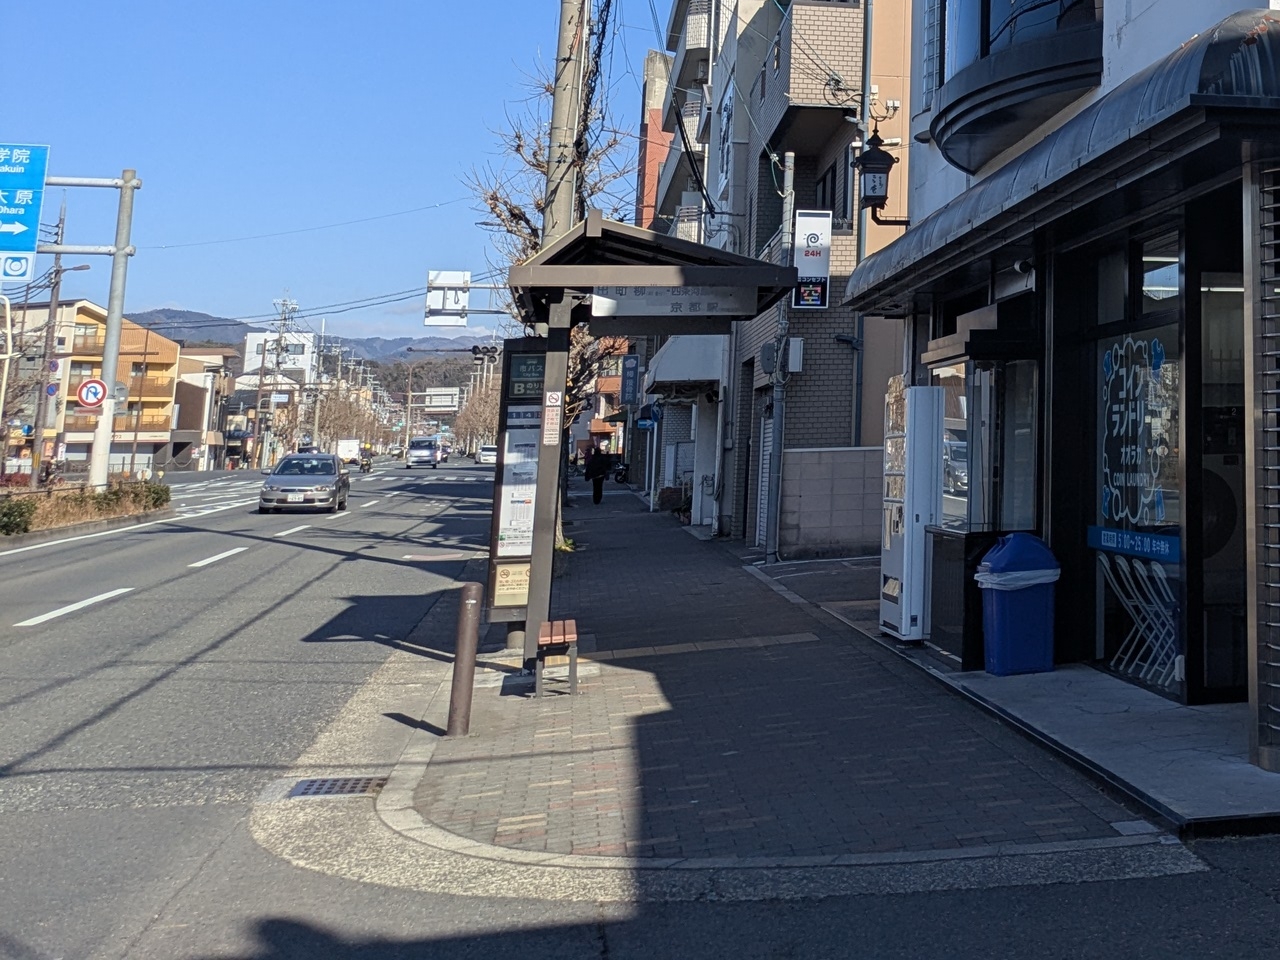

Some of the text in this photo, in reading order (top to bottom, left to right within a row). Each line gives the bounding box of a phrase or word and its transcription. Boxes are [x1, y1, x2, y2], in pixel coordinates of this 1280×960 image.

[514, 383, 525, 395] B
[1119, 365, 1144, 400] コイン
[1113, 473, 1125, 486] COIN
